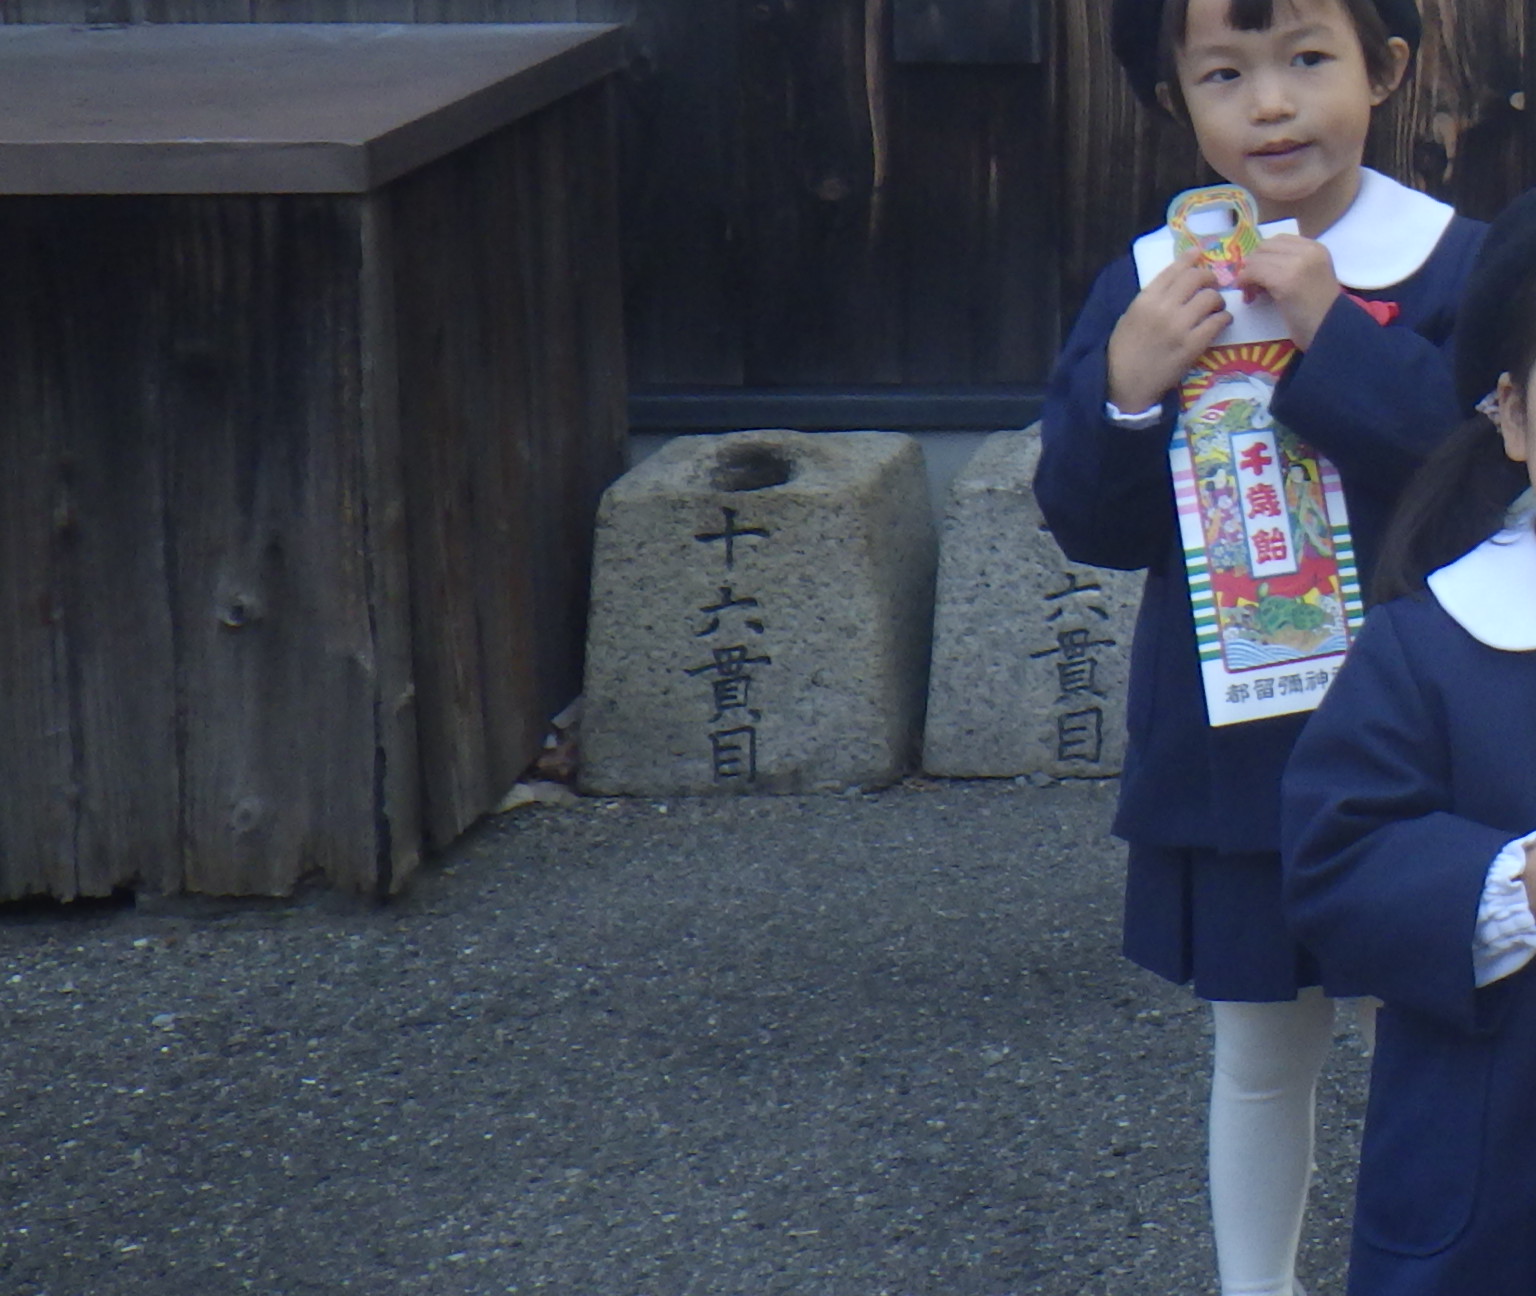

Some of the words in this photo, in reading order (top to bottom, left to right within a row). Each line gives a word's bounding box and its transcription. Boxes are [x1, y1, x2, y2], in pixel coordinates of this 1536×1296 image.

[1239, 440, 1288, 567] 千歳飴
[683, 506, 772, 783] 十六貫目
[1030, 524, 1116, 764] 六貫目
[1225, 667, 1341, 704] 都留彌神
